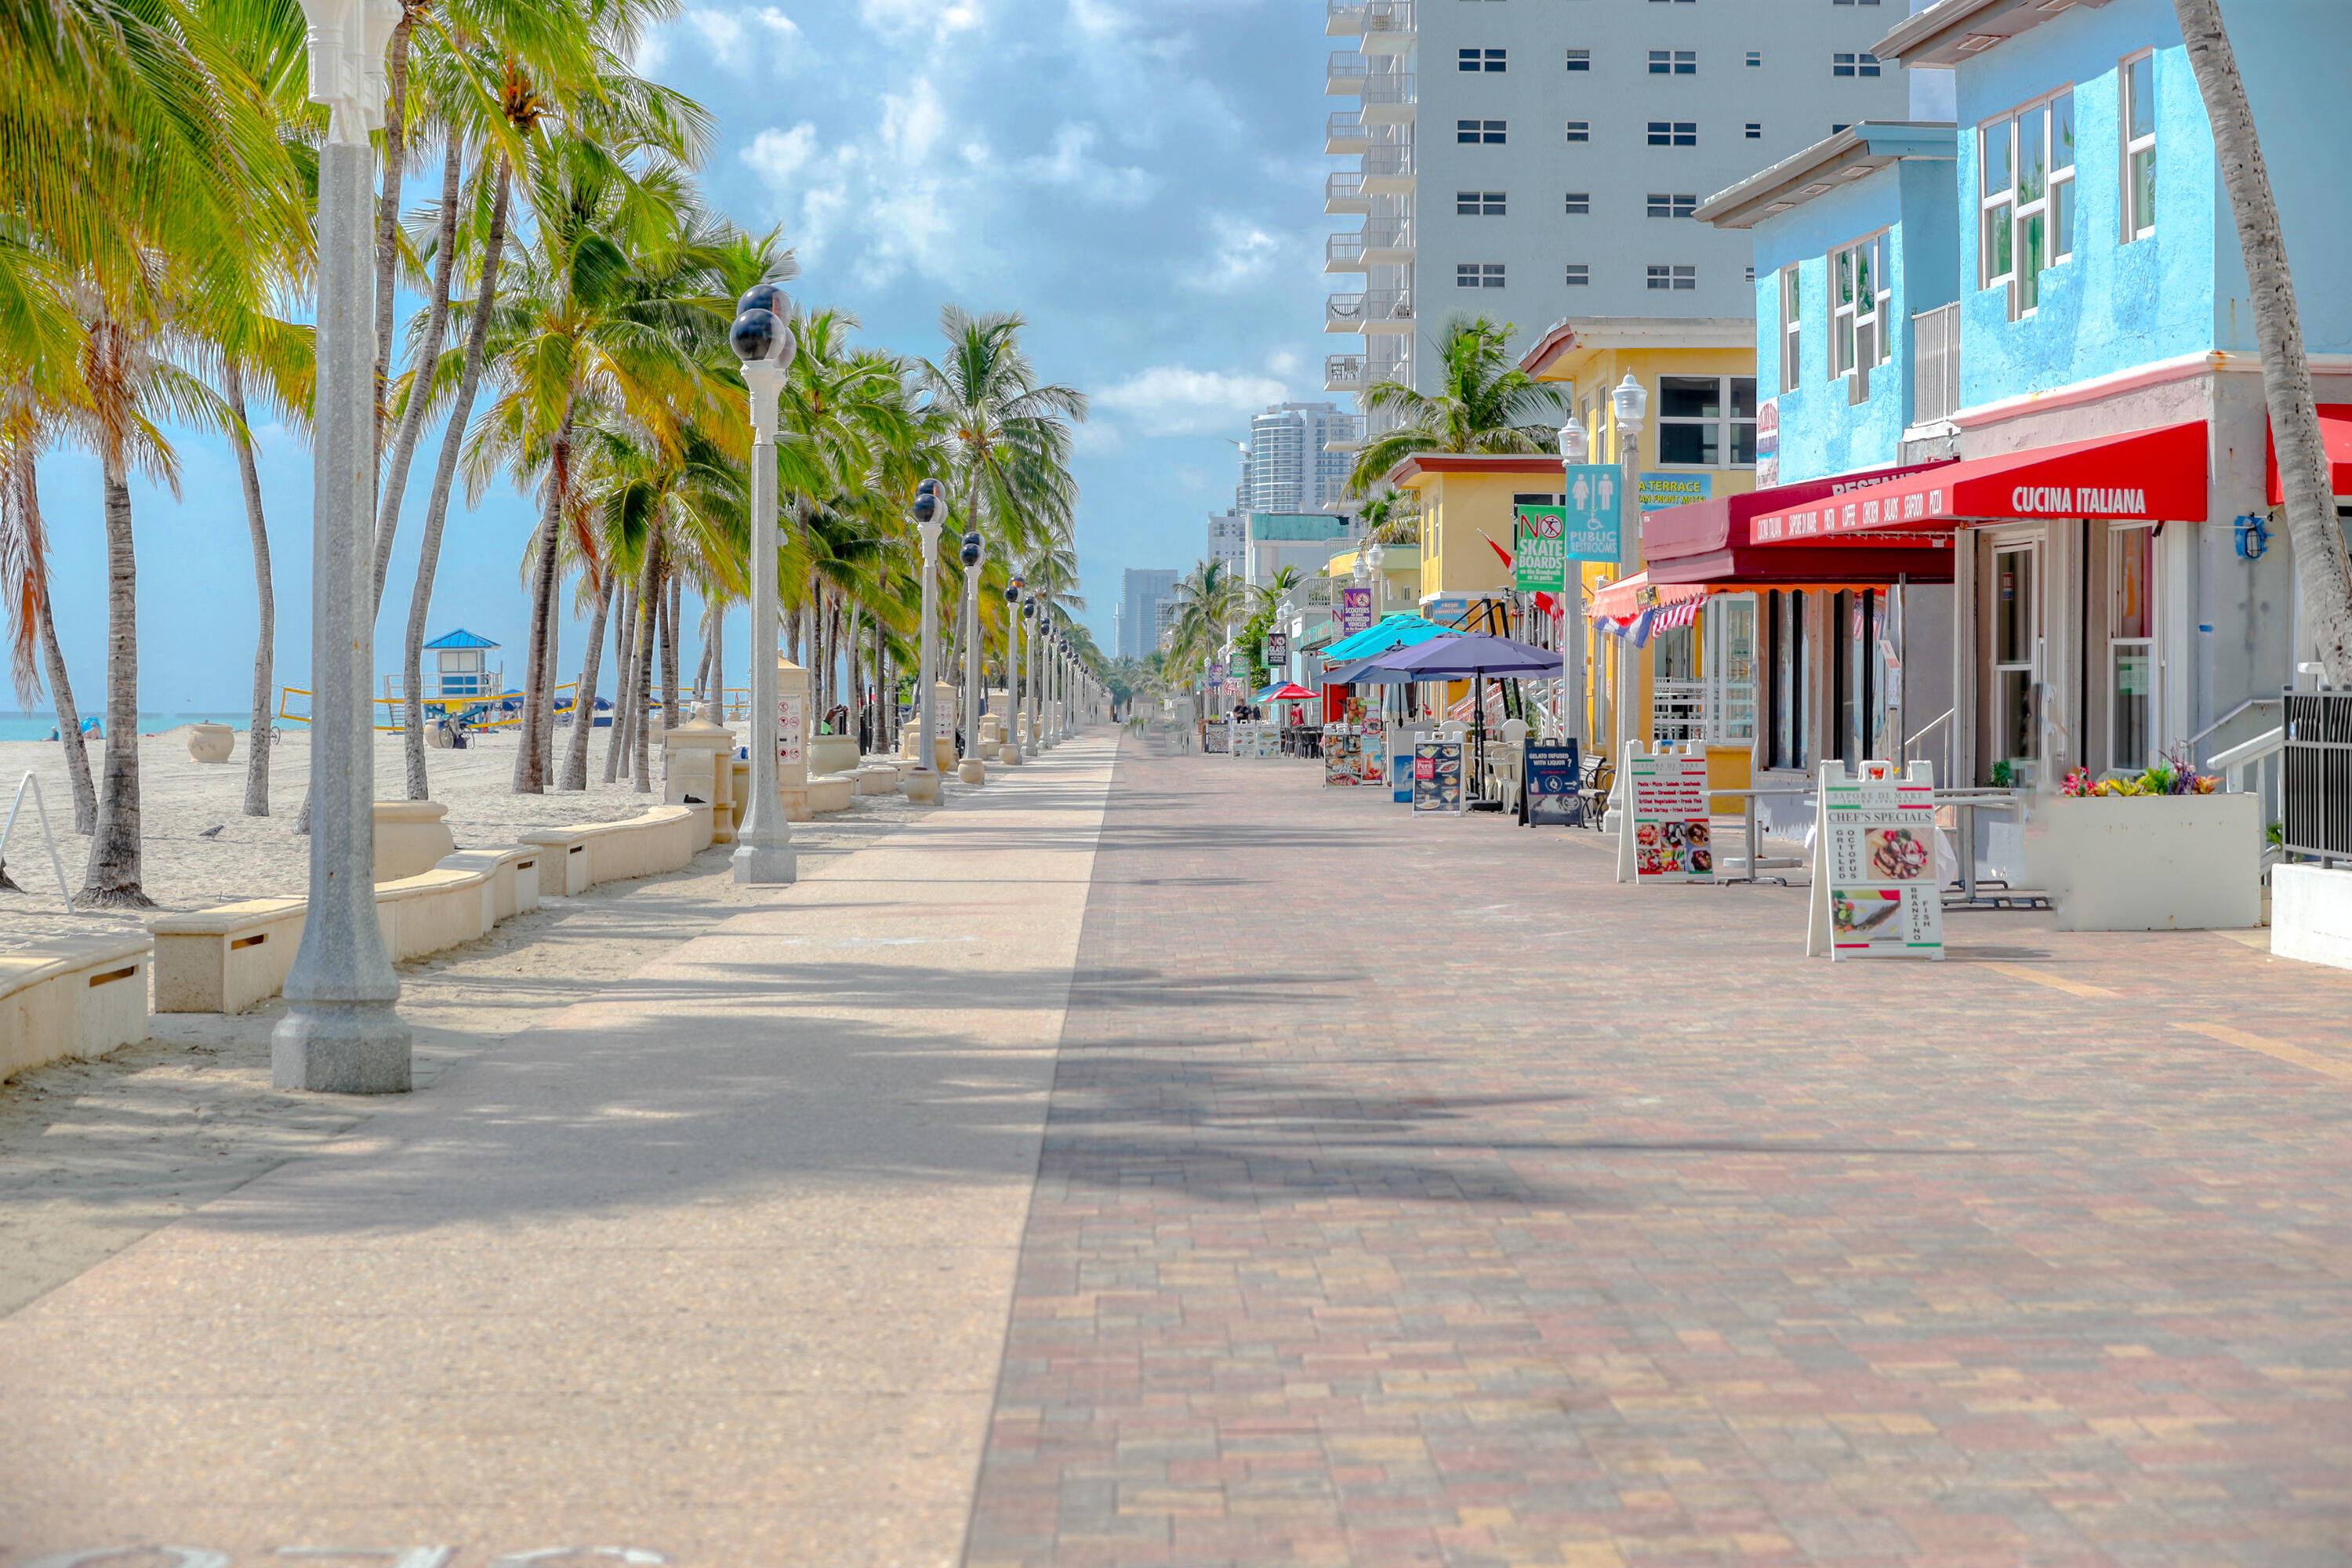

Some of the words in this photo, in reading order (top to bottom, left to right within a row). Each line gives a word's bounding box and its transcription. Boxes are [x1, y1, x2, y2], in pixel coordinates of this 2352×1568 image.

[1649, 481, 1700, 492] TERRACE
[1653, 495, 1679, 503] FRONT
[2012, 487, 2072, 513] CUCINA
[2076, 488, 2147, 514] ITALIANA
[1824, 508, 1835, 531] PASTA
[1863, 500, 1879, 524] CHICKEN
[1884, 497, 1899, 521] SALADS
[1904, 492, 1924, 519] SEAFOOD
[1929, 489, 1942, 515] PIZZA
[1570, 532, 1617, 541] PUBLIC
[1519, 539, 1563, 557] SKATE
[1570, 542, 1617, 553] RESTROOMS
[1519, 556, 1563, 569] BOARDS
[1332, 609, 1343, 622] N
[1828, 811, 1871, 822] CHEF'S
[1874, 812, 1931, 822] SPECIALS
[1836, 829, 1846, 879] GRILLED
[1847, 829, 1857, 879] OCTOPUS
[1911, 887, 1921, 941] BRANZINO
